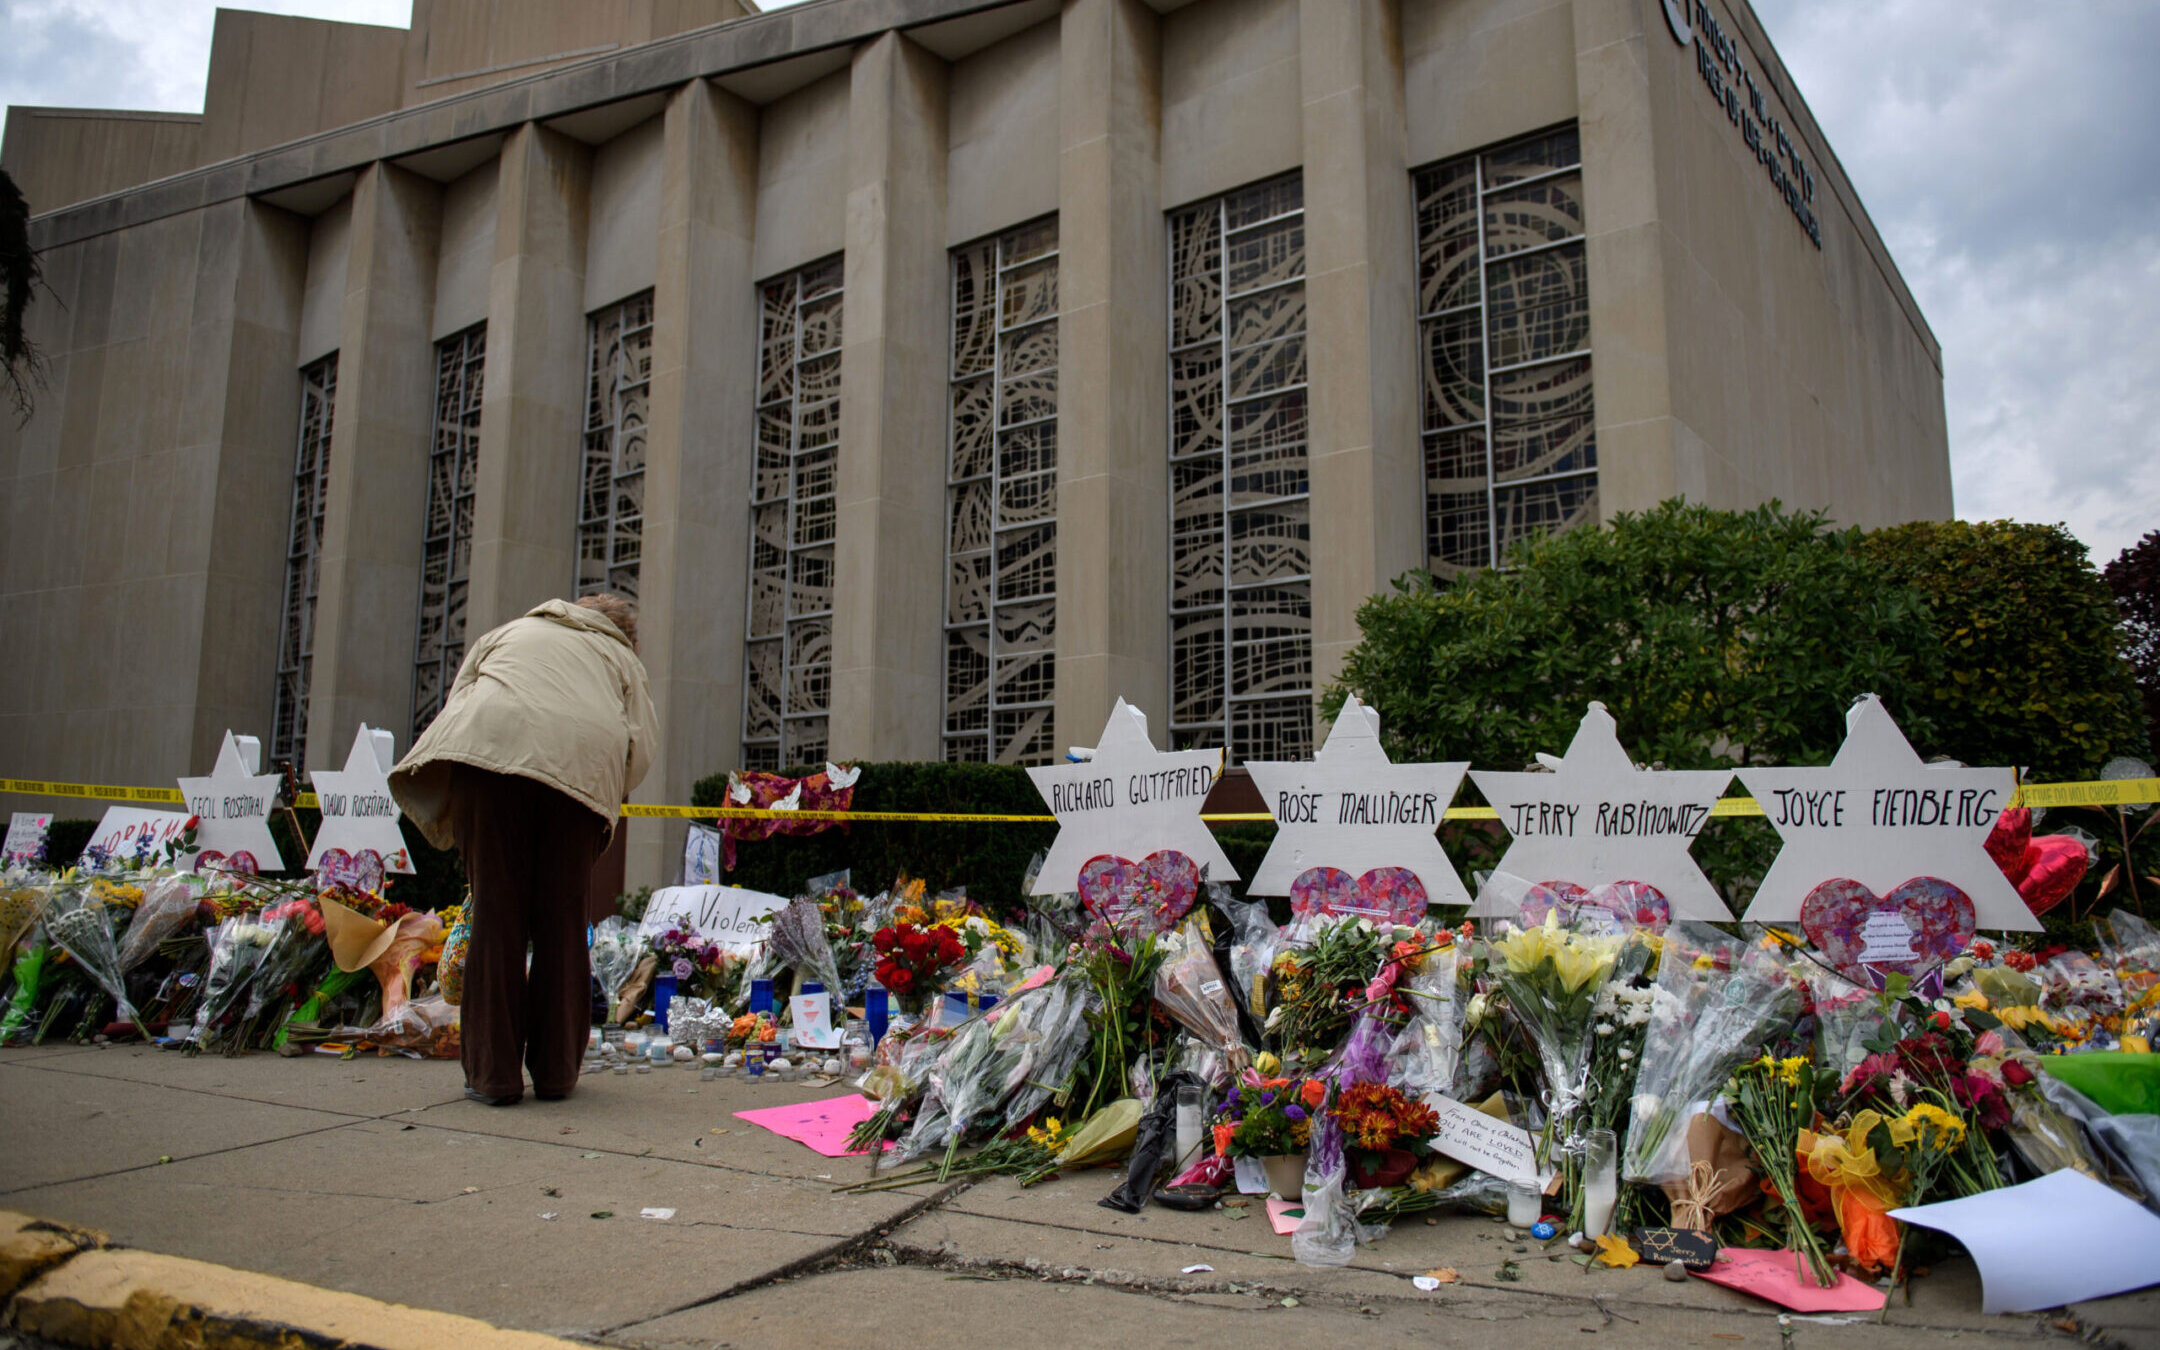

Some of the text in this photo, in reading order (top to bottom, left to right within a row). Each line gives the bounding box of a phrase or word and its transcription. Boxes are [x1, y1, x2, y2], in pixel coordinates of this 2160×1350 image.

[1694, 36, 1725, 107] TREE
[1726, 86, 1740, 127] OF
[1741, 108, 1764, 165] LIFE
[192, 795, 264, 820] CECIL ROSENTHAL
[323, 793, 347, 817] DAVID
[351, 795, 394, 818] ROSENTHAL
[1278, 791, 1437, 825] ROSE MALLINGER
[1509, 800, 1710, 838] JERRY RABINOWITZ
[1772, 788, 1999, 827] JOYCE FIENBERG
[699, 891, 771, 935] Violenc
[1438, 1118, 1523, 1157] OU ARE LOVED
[1670, 1246, 1696, 1257] Jerry
